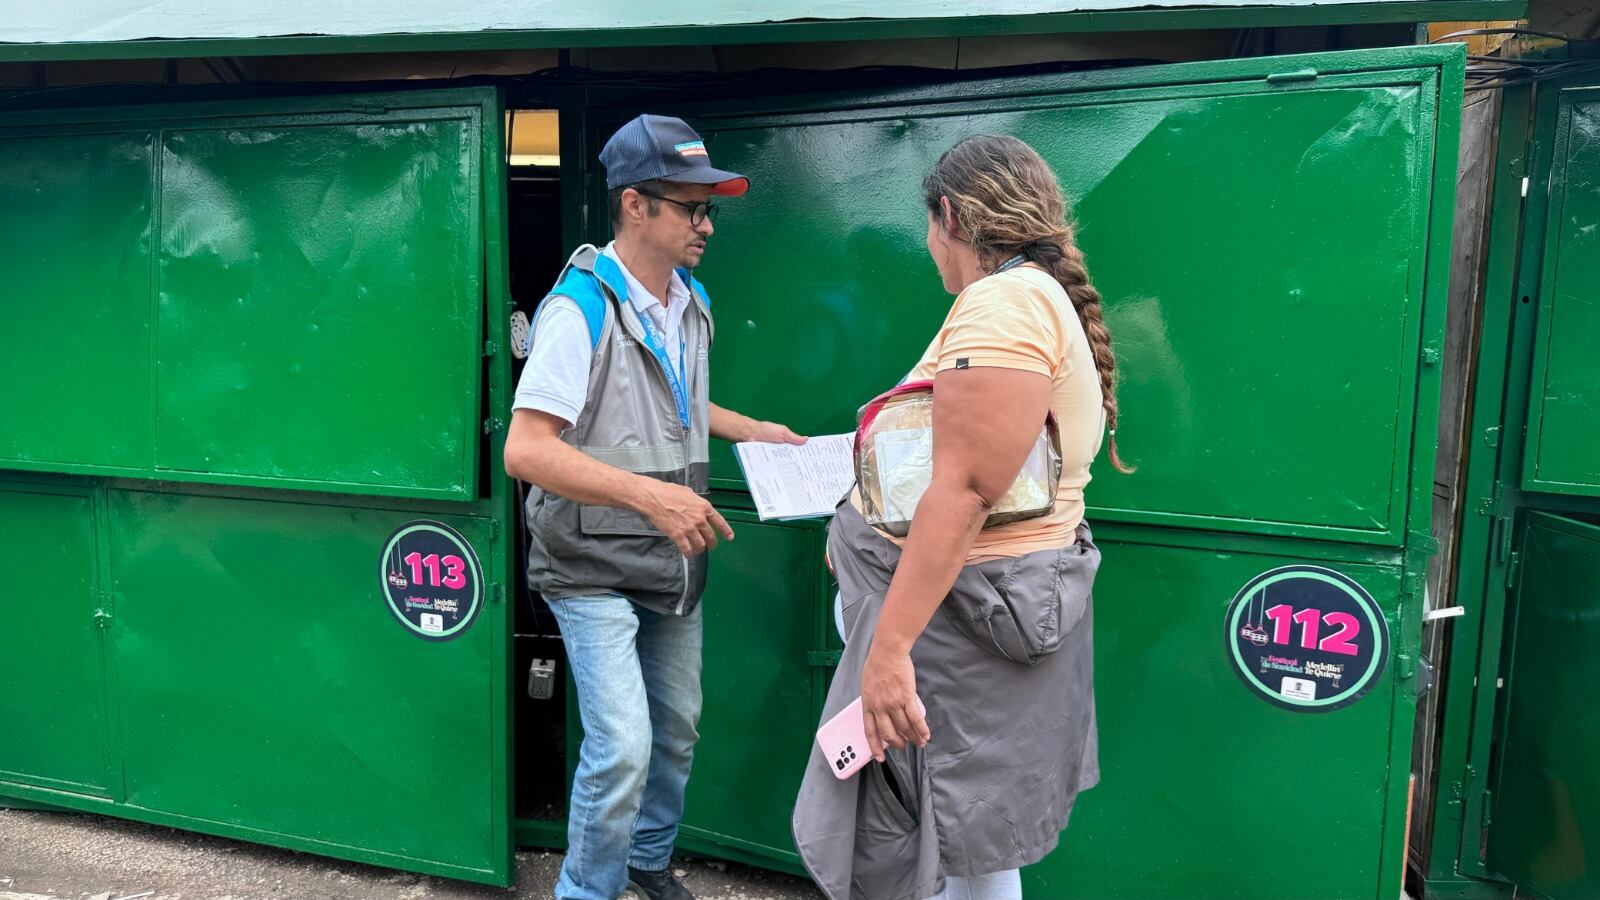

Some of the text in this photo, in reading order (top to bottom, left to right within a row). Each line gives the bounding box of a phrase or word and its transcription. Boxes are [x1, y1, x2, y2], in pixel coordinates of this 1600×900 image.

[404, 552, 466, 590] 113
[1265, 604, 1360, 656] 112
[1268, 655, 1297, 666] Festival
[1306, 661, 1341, 673] Medellín
[1304, 667, 1341, 680] Te Quiere
